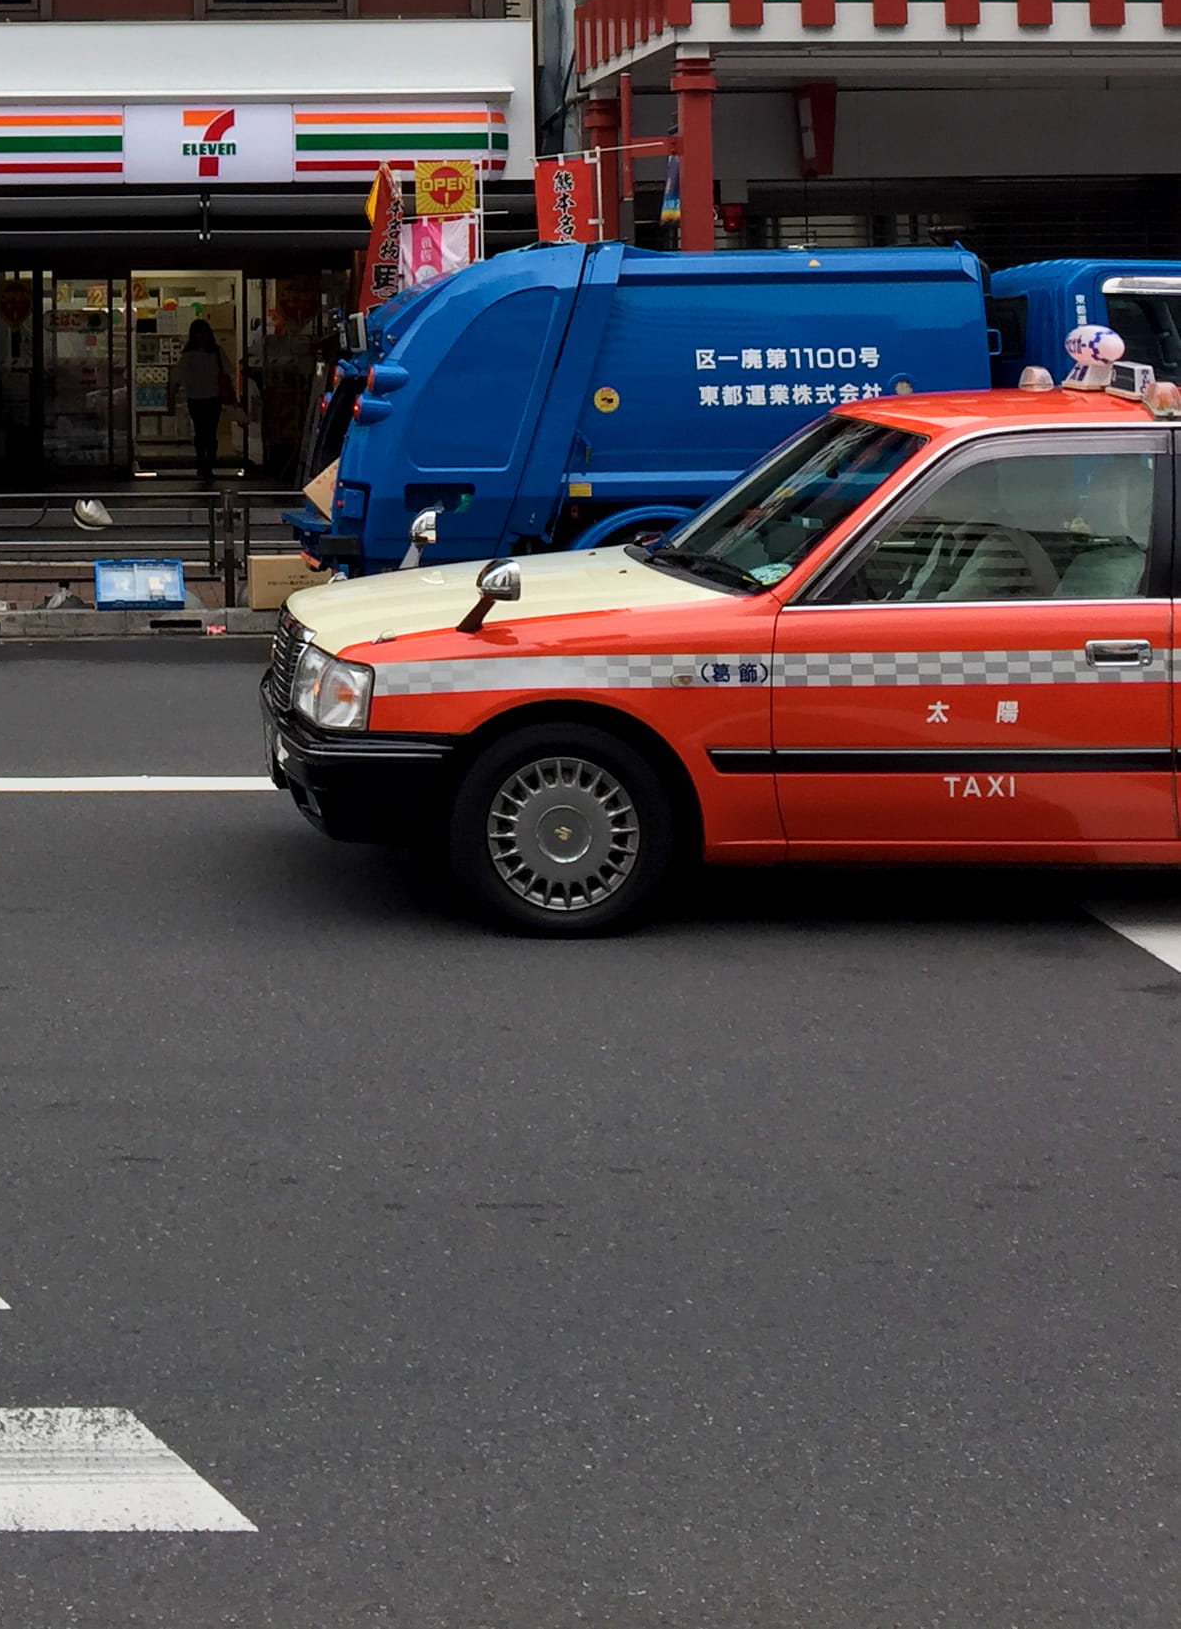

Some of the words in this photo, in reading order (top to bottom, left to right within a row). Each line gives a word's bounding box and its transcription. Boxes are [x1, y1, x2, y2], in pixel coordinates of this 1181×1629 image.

[421, 177, 471, 192] OPEN
[552, 170, 577, 242] 熊本名
[695, 346, 880, 370] 区一廃第1100号
[927, 701, 1020, 725] 太陽
[944, 776, 1017, 798] TAXI
